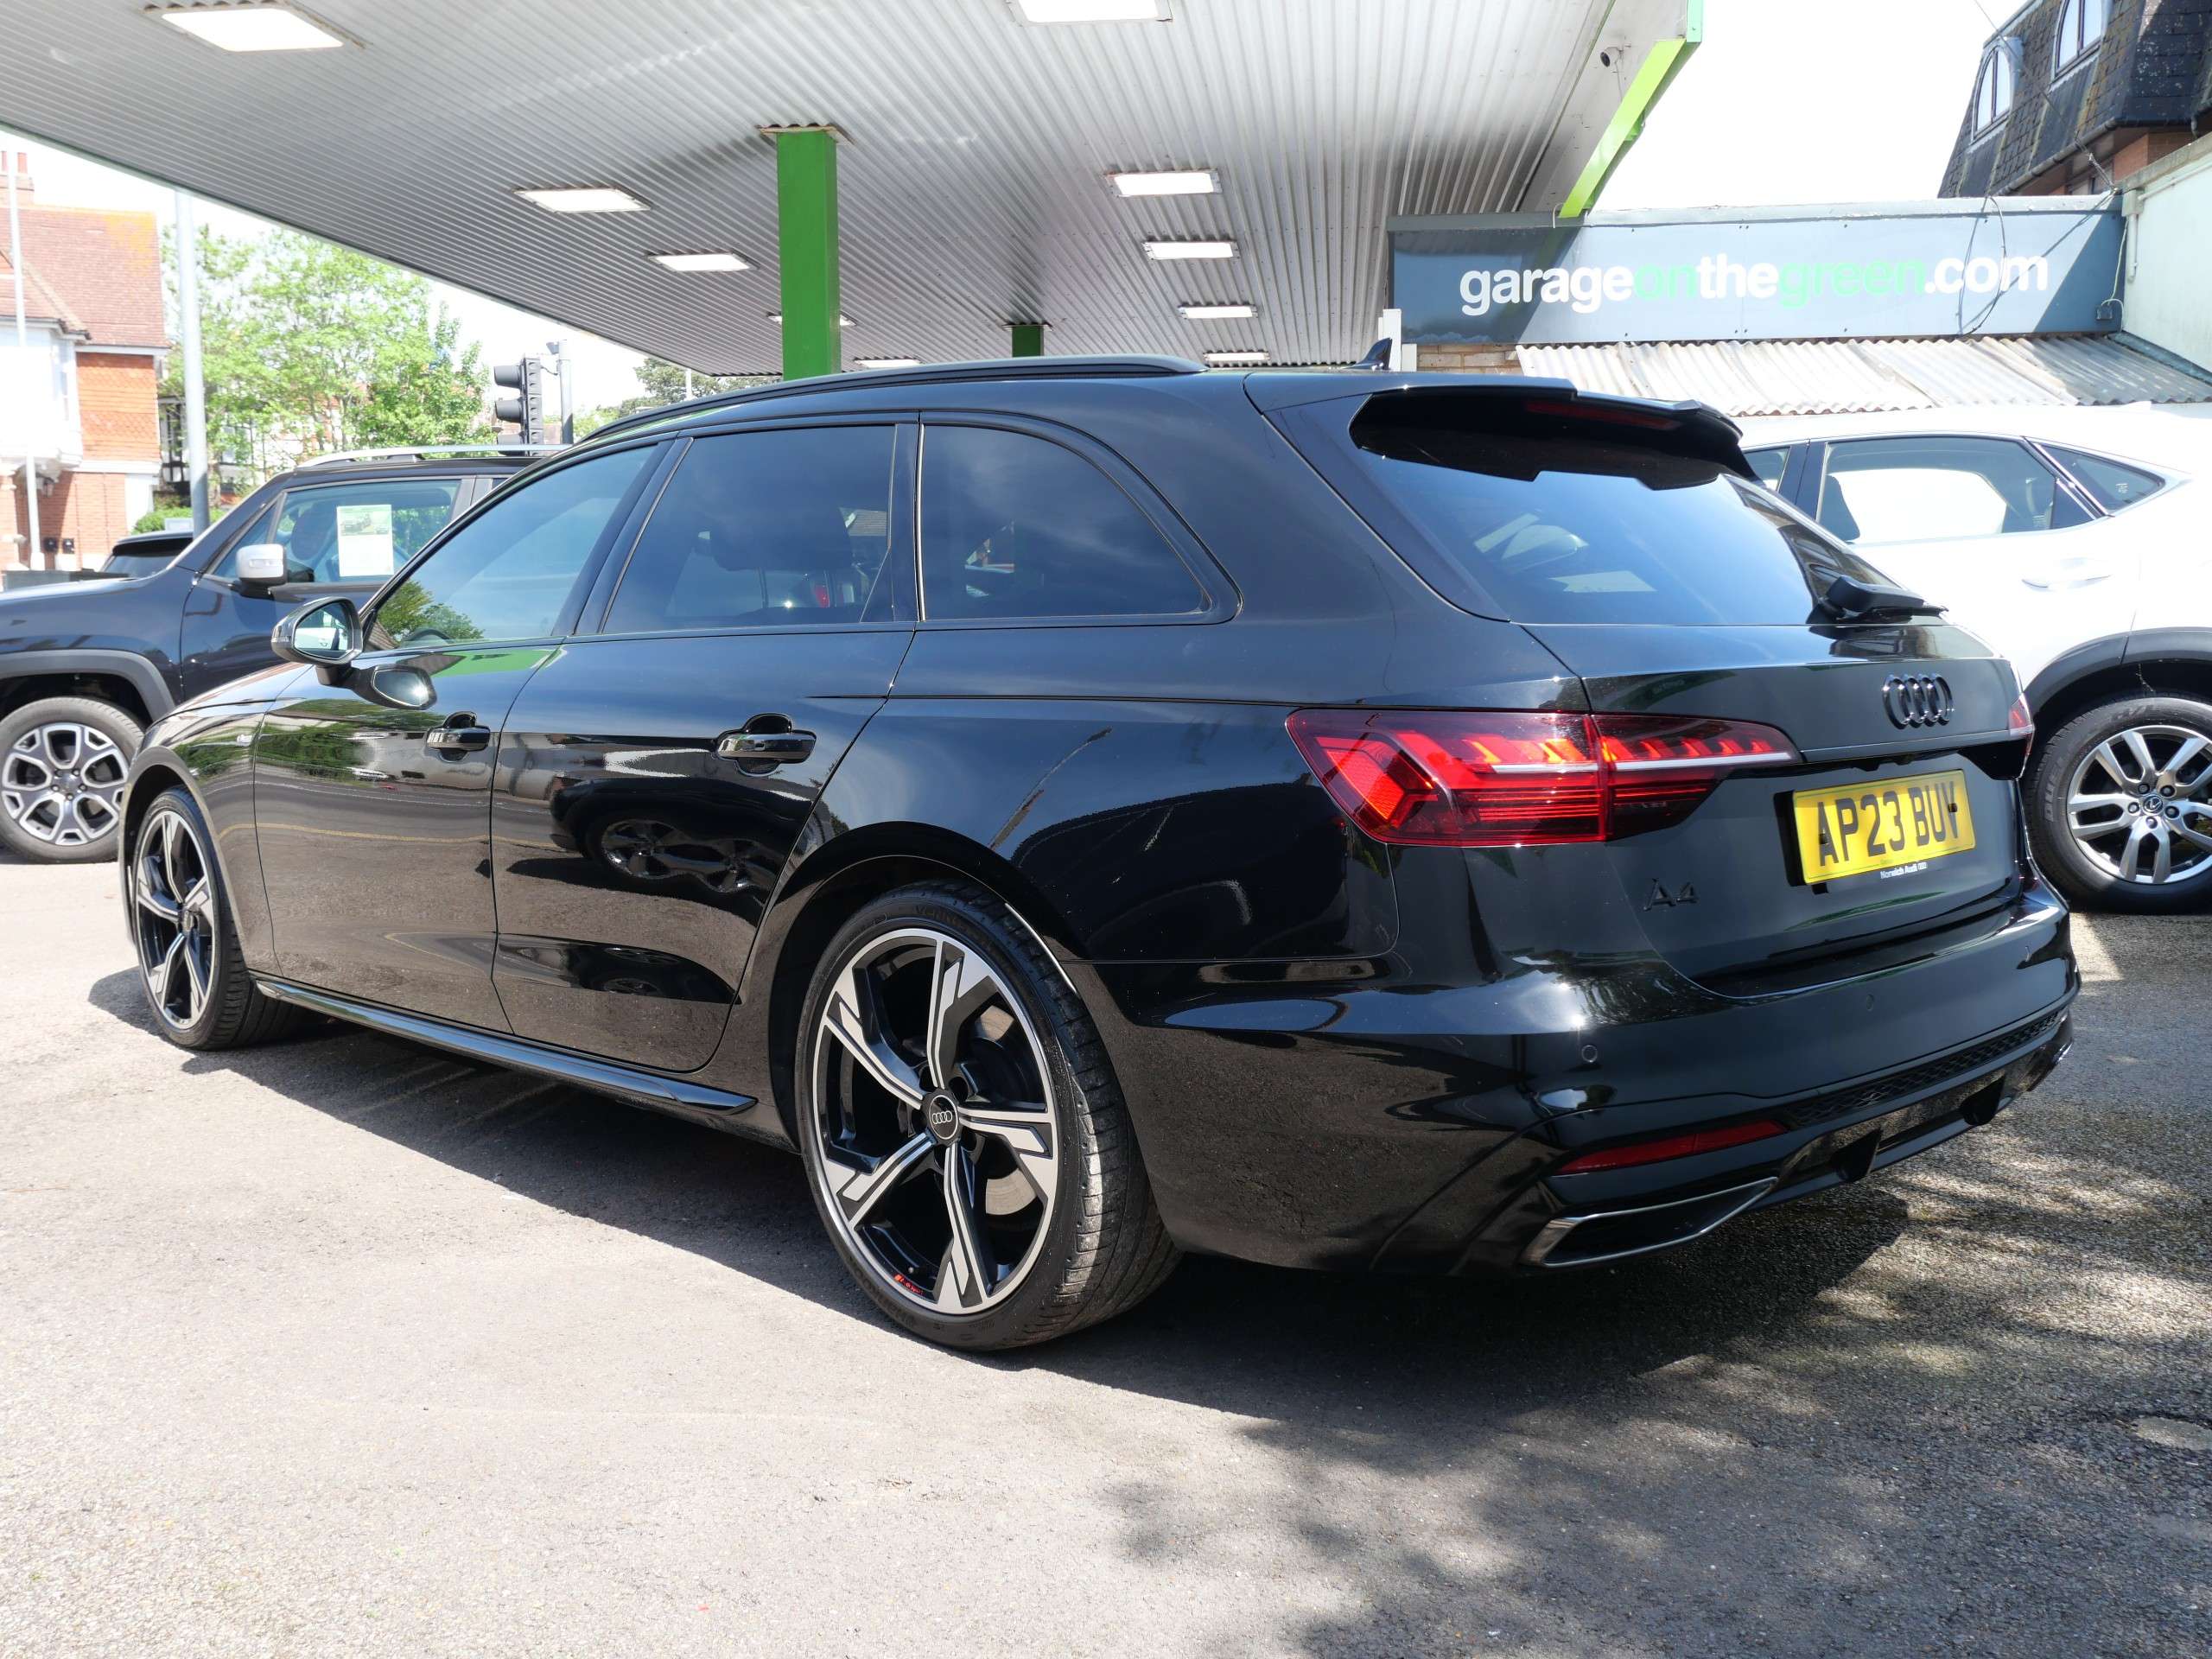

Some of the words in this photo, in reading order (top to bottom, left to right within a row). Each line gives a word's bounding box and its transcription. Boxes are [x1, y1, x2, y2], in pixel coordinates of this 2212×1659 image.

[1459, 252, 2049, 315] garageonthegreen.com
[1816, 790, 1905, 867] AP23
[1907, 780, 1959, 848] BUV
[1643, 877, 1700, 912] A4
